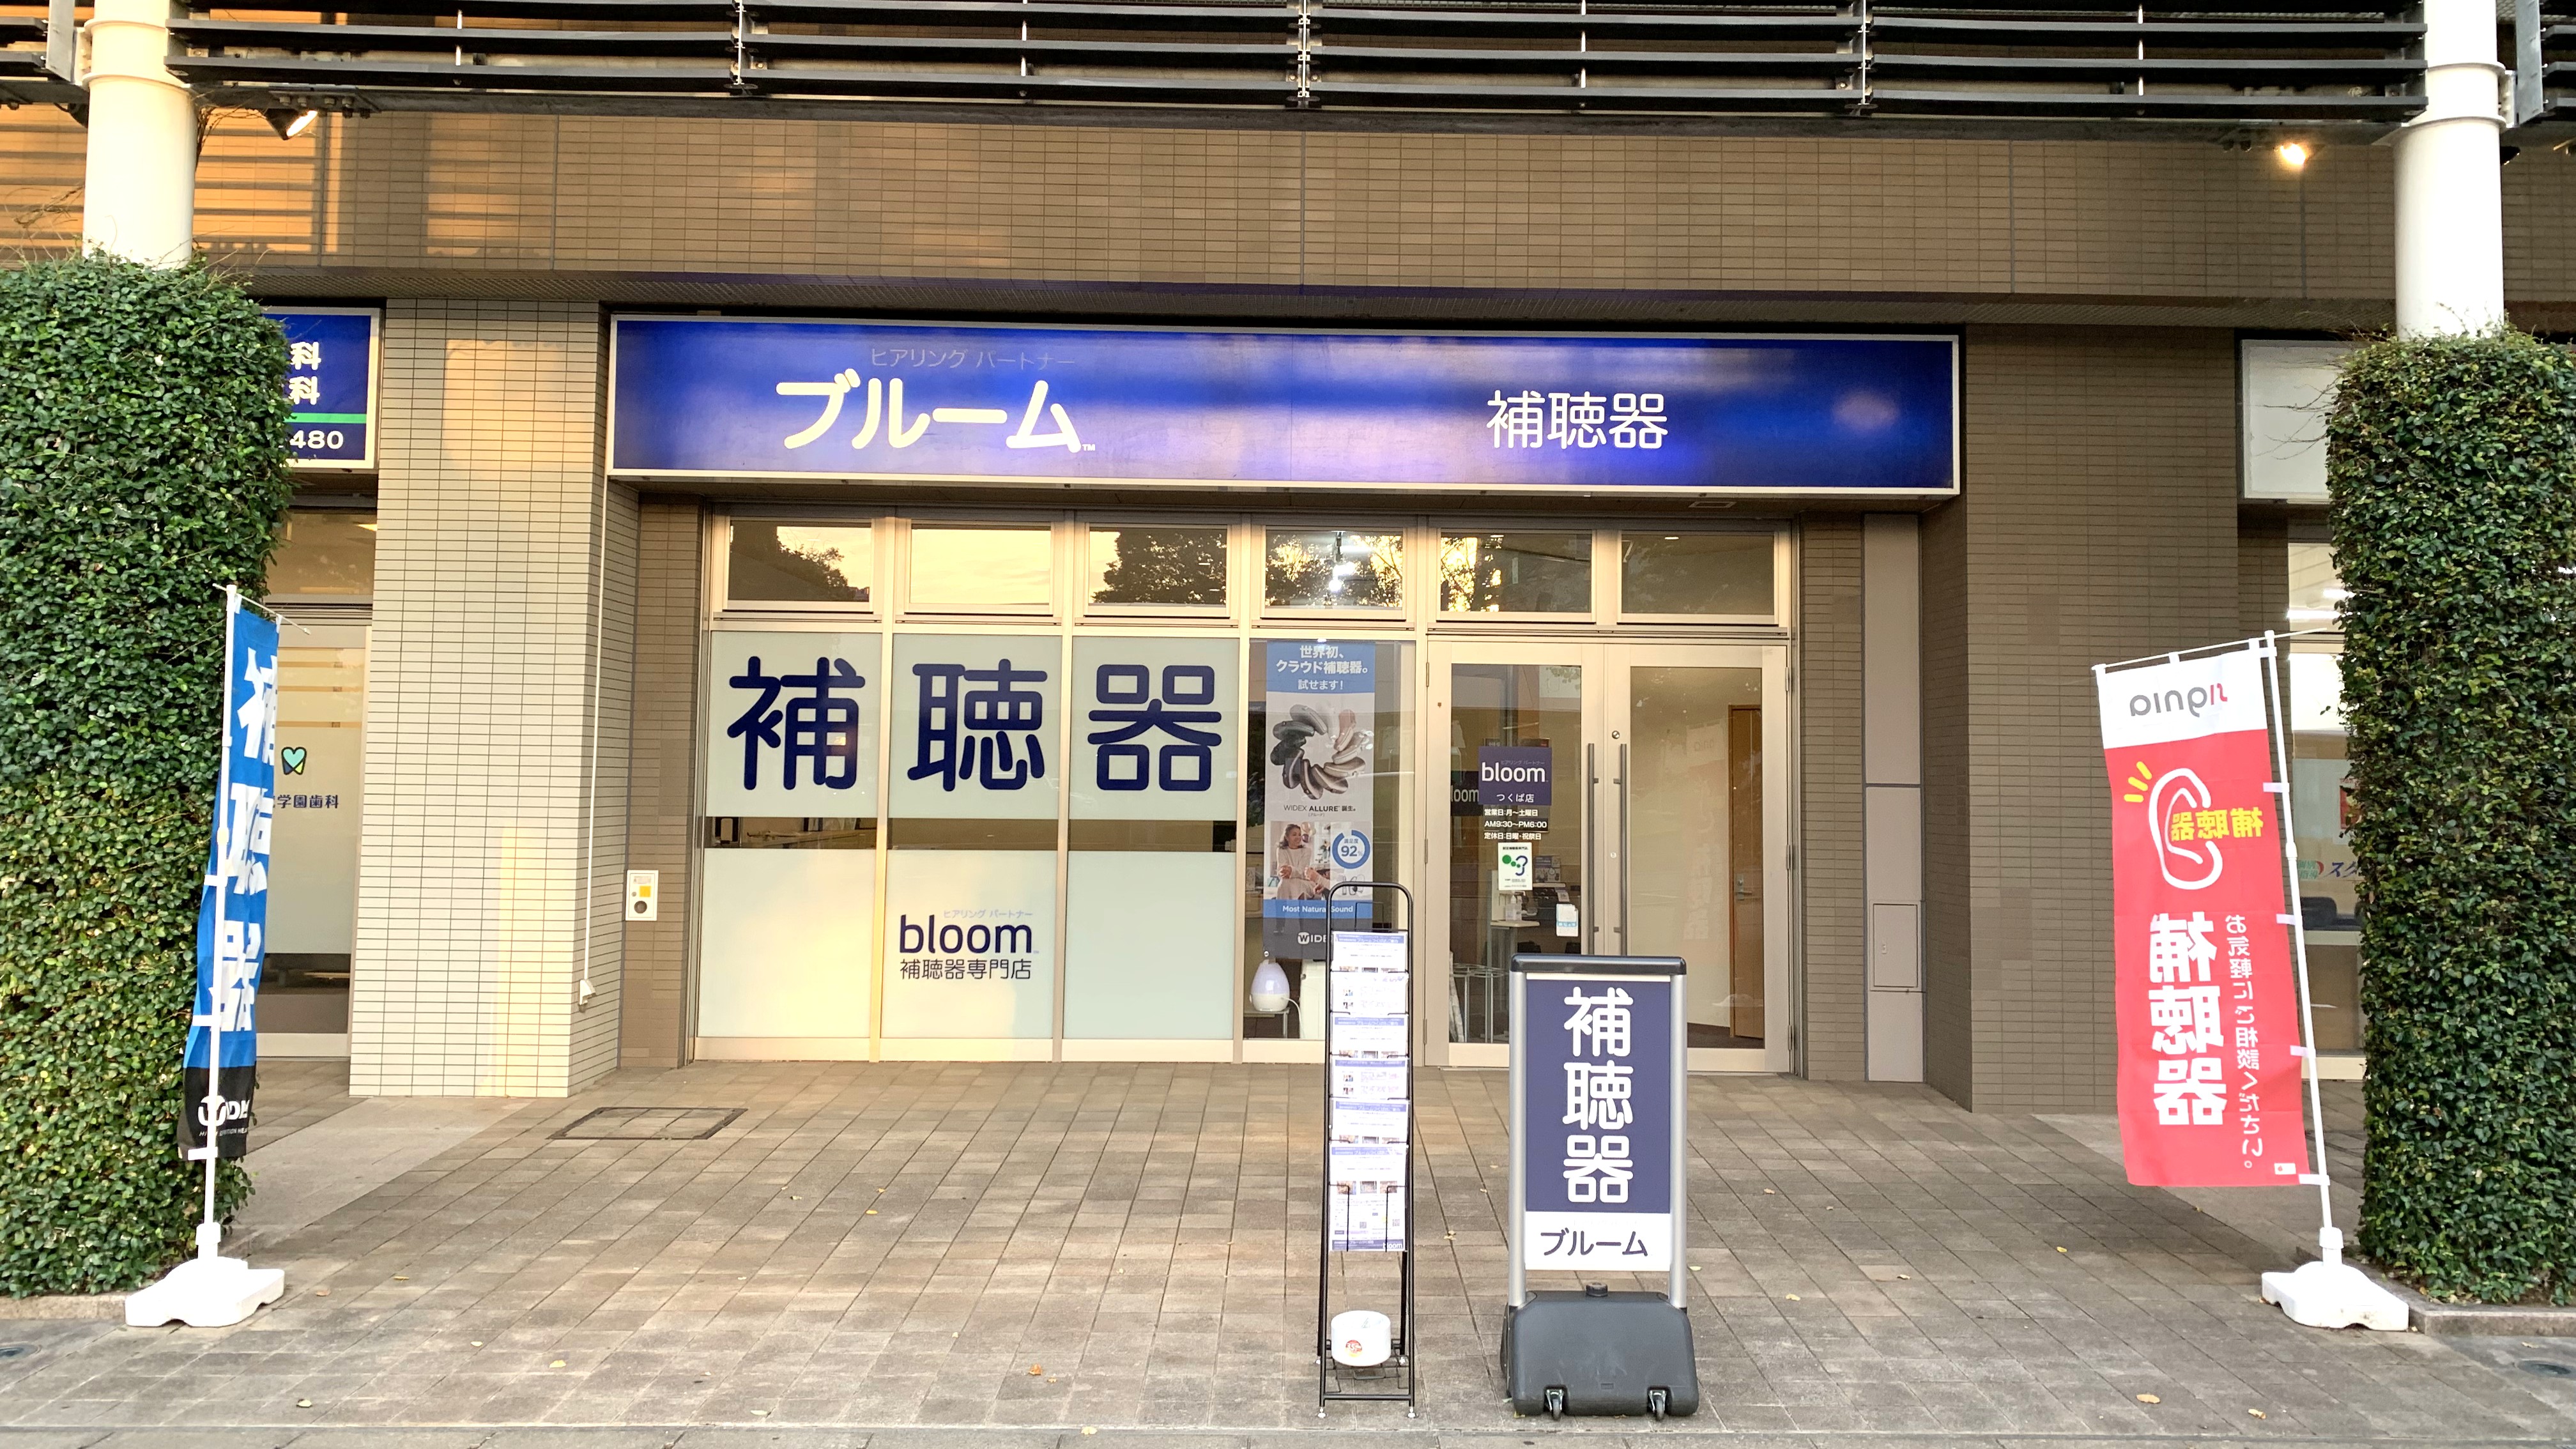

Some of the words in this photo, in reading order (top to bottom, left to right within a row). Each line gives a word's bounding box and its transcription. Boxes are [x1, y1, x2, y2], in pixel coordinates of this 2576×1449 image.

[871, 348, 967, 368] ヒアリング
[976, 351, 1075, 370] パートナー
[776, 369, 1082, 453] ブルーム
[1486, 390, 1668, 449] 補聴器
[279, 430, 344, 449] 480
[1300, 645, 1344, 659] 世界初、
[1276, 659, 1368, 674] クラウド補聴器。
[726, 656, 1222, 792] 補聴器
[1482, 762, 1545, 782] bloom
[273, 794, 339, 808] 学園歯科
[1451, 785, 1479, 802] loom
[1496, 793, 1535, 802] つくば店
[944, 910, 986, 918] ヒアリング
[990, 910, 1033, 918] パートナー
[900, 914, 1032, 954] bloom
[1298, 931, 1327, 944] WIDE
[900, 958, 1032, 979] 補聴器専門店
[1563, 986, 1634, 1203] 補聴器
[1541, 1227, 1648, 1257] ブルーム
